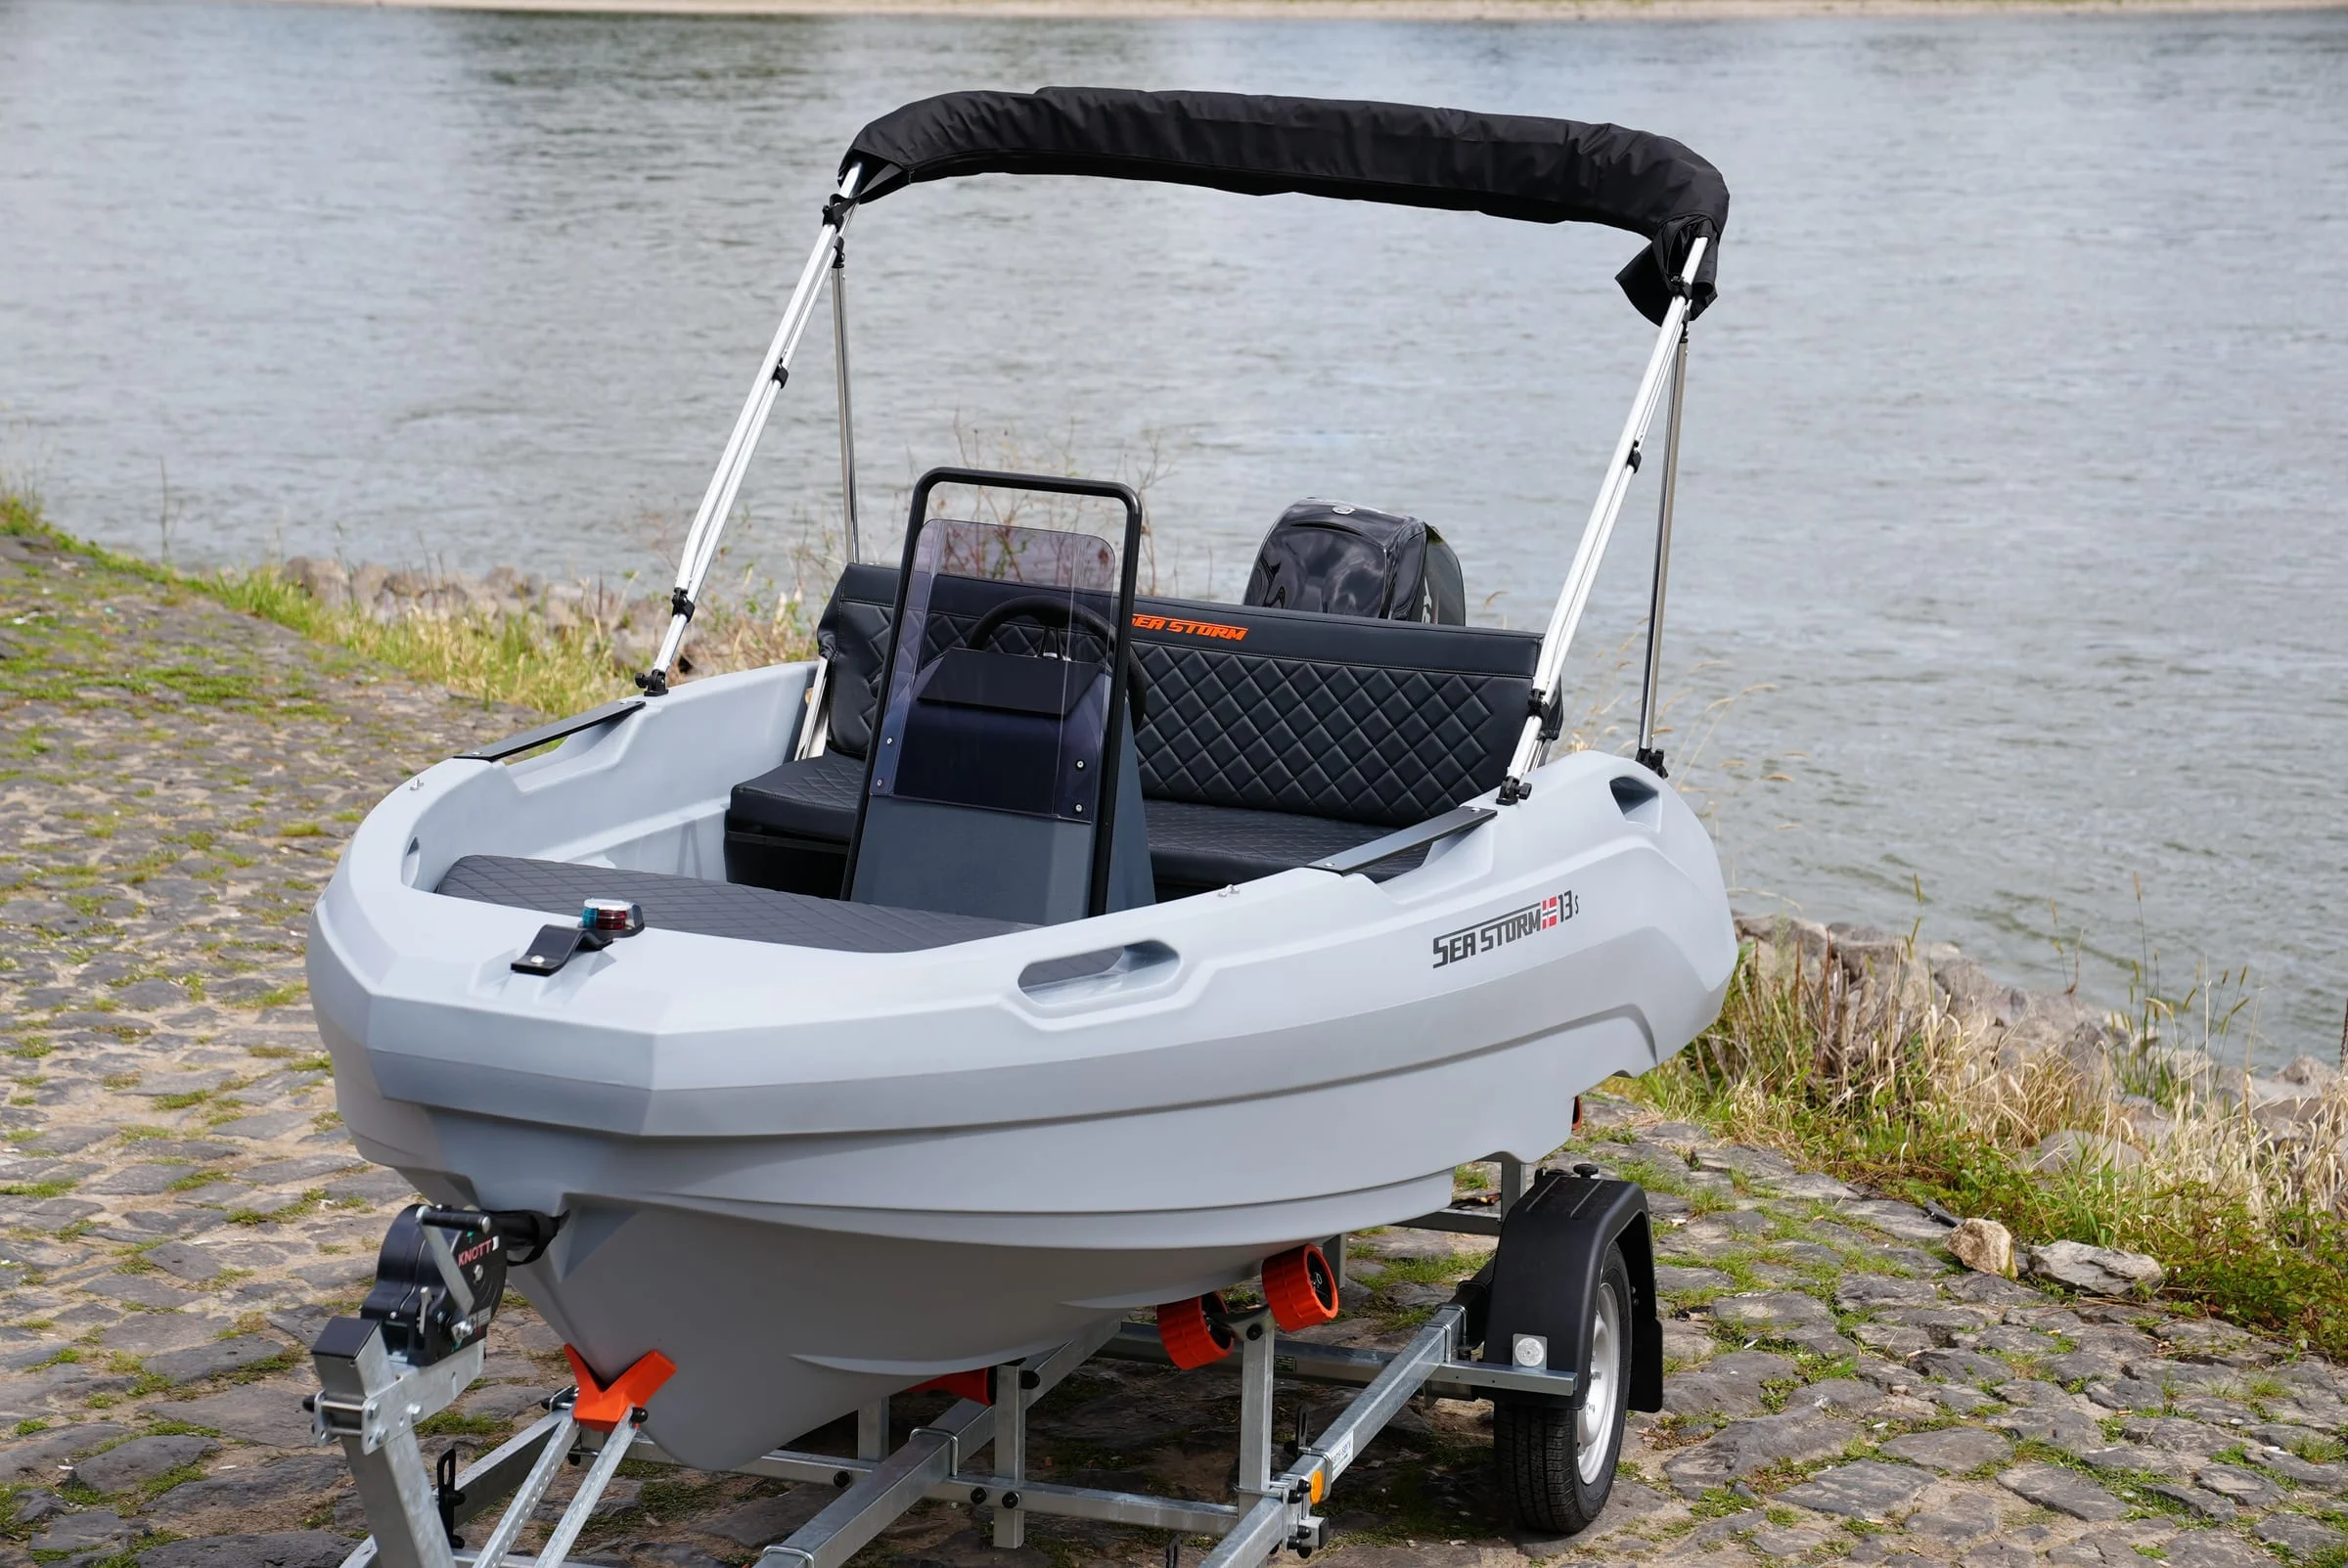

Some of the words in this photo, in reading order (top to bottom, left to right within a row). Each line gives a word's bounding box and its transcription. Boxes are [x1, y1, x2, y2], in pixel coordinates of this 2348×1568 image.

[1132, 614, 1166, 631] EA
[1166, 620, 1248, 642] STORM
[1433, 930, 1476, 968] SEA
[1480, 906, 1541, 952] STORM
[458, 1238, 492, 1268] KNOTT
